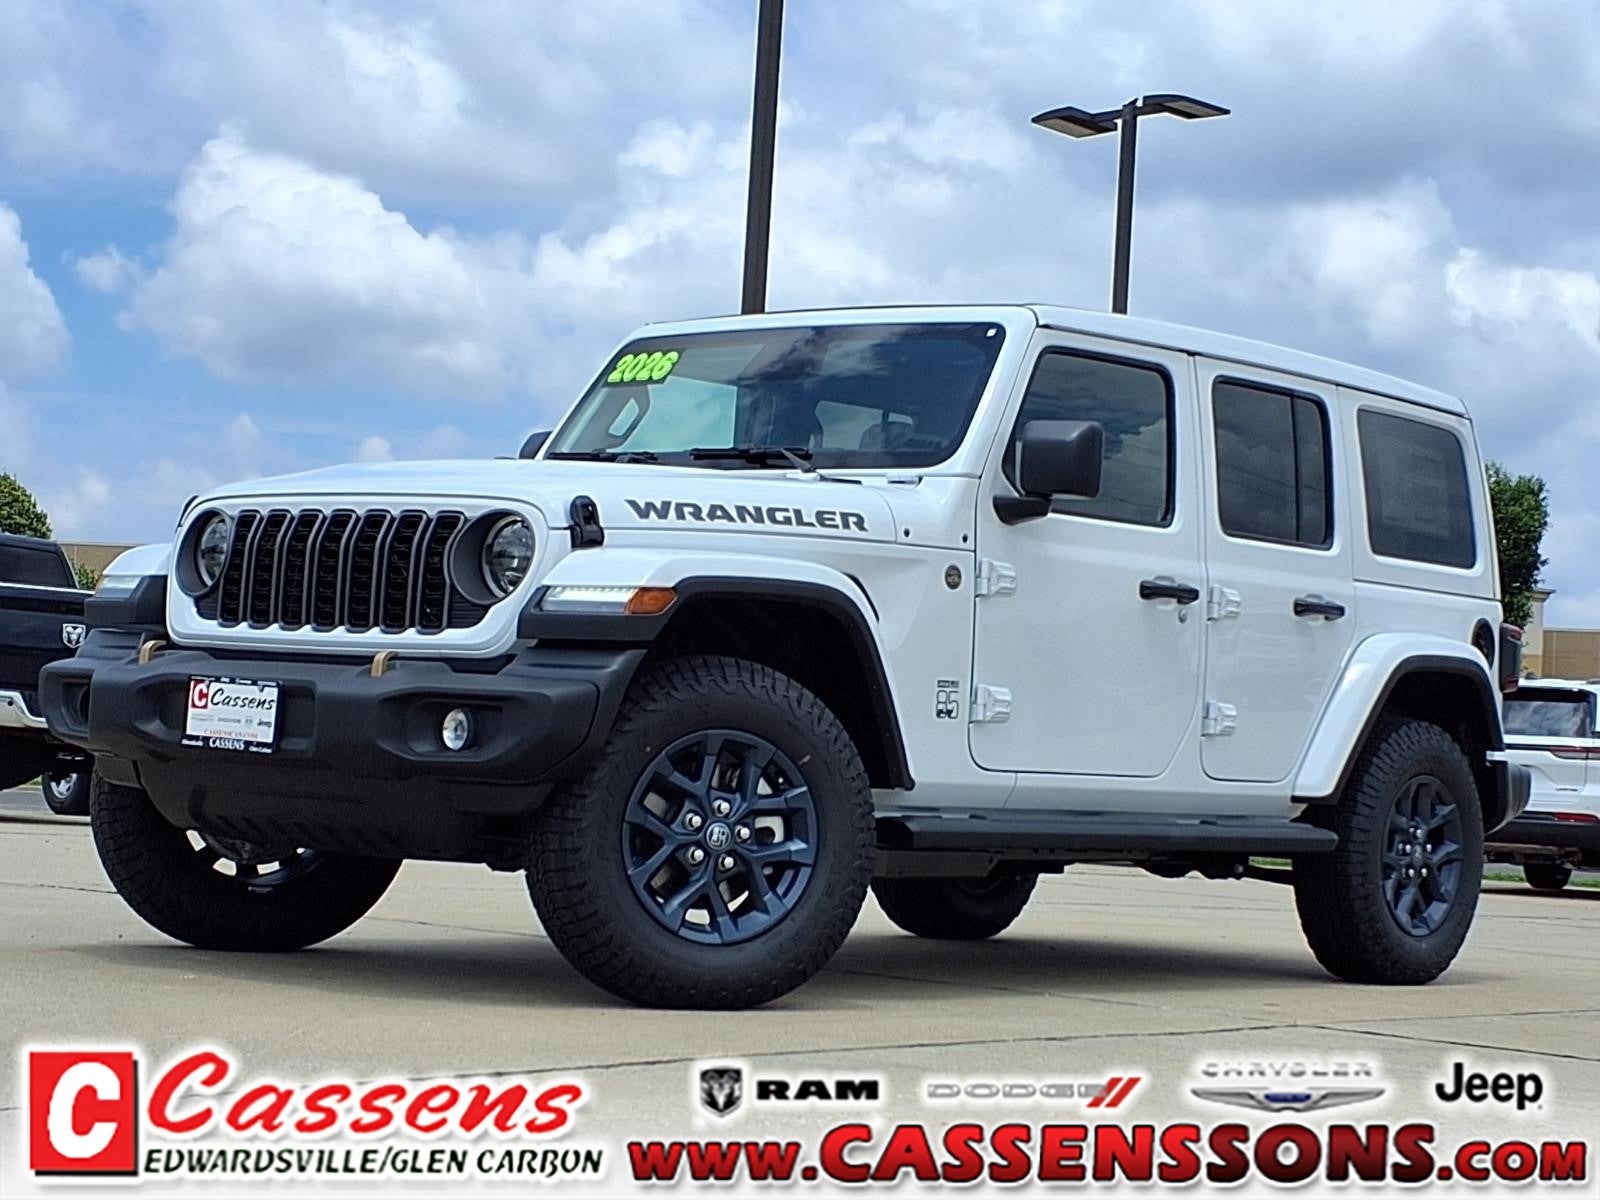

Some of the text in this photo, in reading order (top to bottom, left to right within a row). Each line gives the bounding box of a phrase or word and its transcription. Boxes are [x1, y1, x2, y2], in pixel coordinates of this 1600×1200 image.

[607, 351, 679, 383] 2026
[624, 499, 868, 532] WRANGLER
[193, 682, 276, 711] C Cassens
[209, 736, 245, 751] CASSENS
